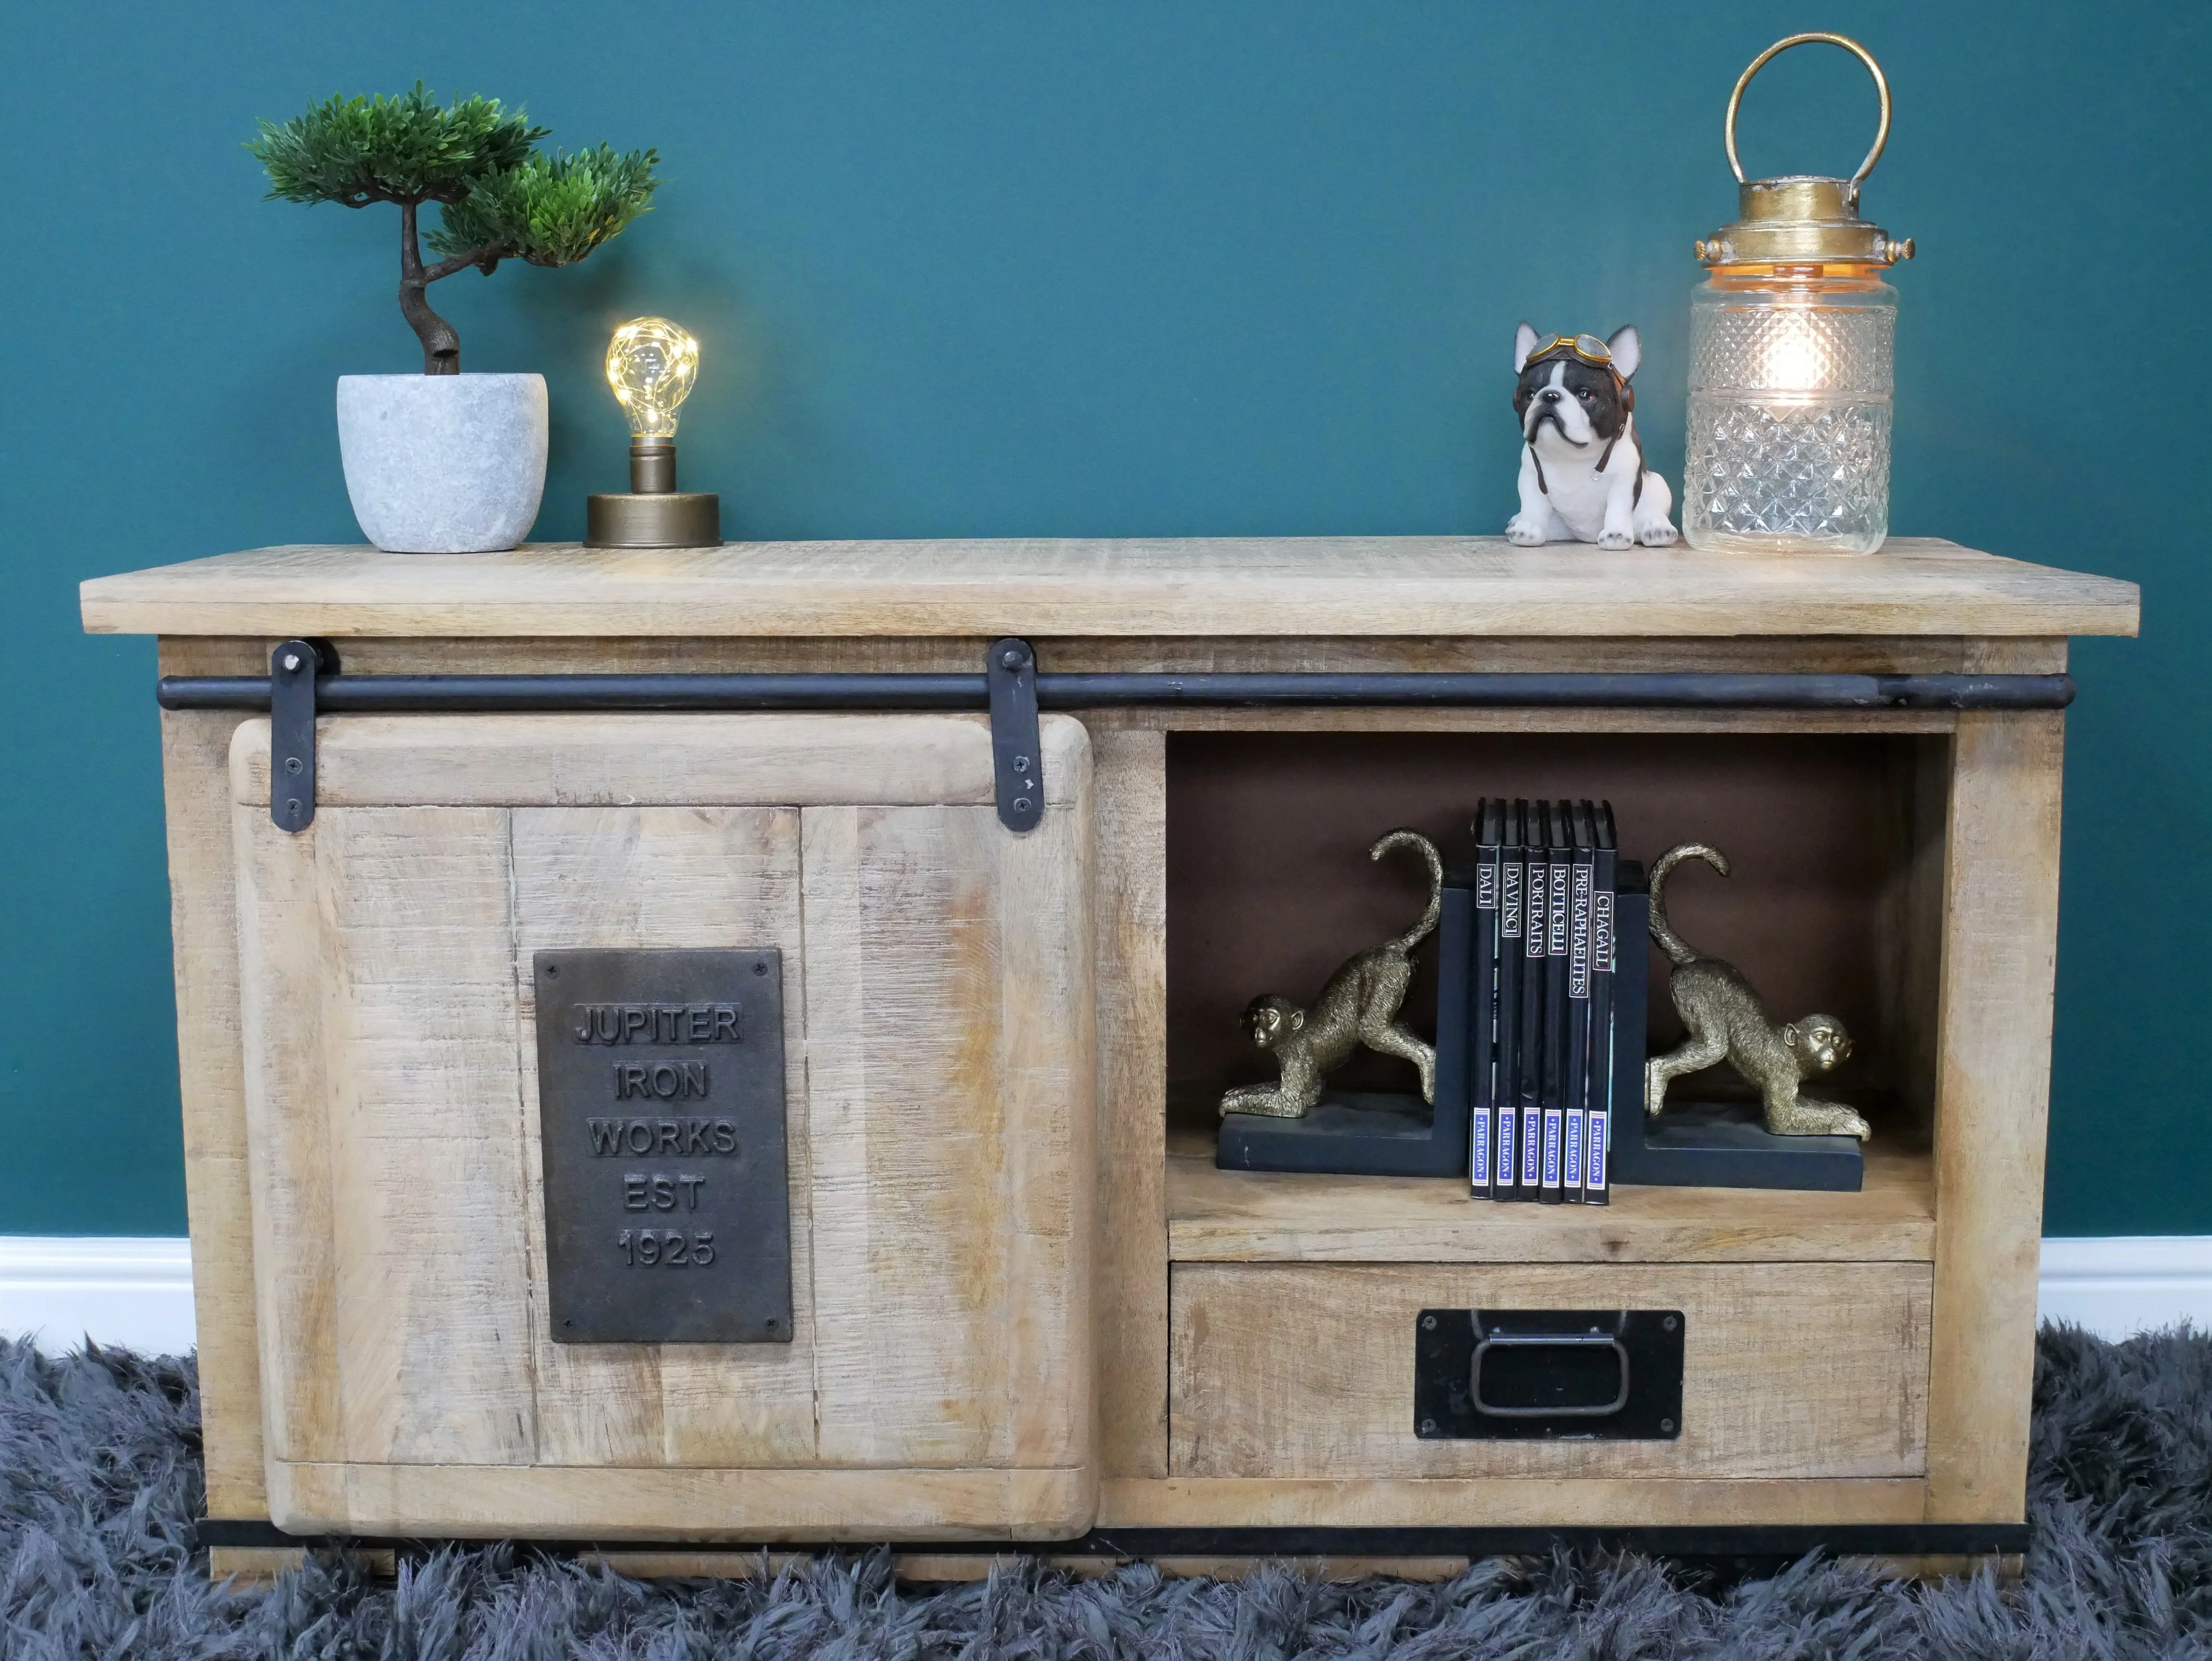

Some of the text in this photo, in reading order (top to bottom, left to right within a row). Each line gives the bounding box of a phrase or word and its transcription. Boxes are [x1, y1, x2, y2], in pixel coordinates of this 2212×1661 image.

[1479, 867, 1492, 905] DALI
[1505, 867, 1519, 934] DA VINCI
[1530, 869, 1544, 954] PORTRAITS
[1552, 869, 1566, 951] BOTTICELLI
[1595, 896, 1610, 967] CHAGALL
[574, 1006, 740, 1042] JUPITER
[613, 1062, 708, 1100] IRON
[587, 1120, 737, 1155] WORKS
[623, 1174, 706, 1210] EST
[618, 1231, 716, 1266] 1925
